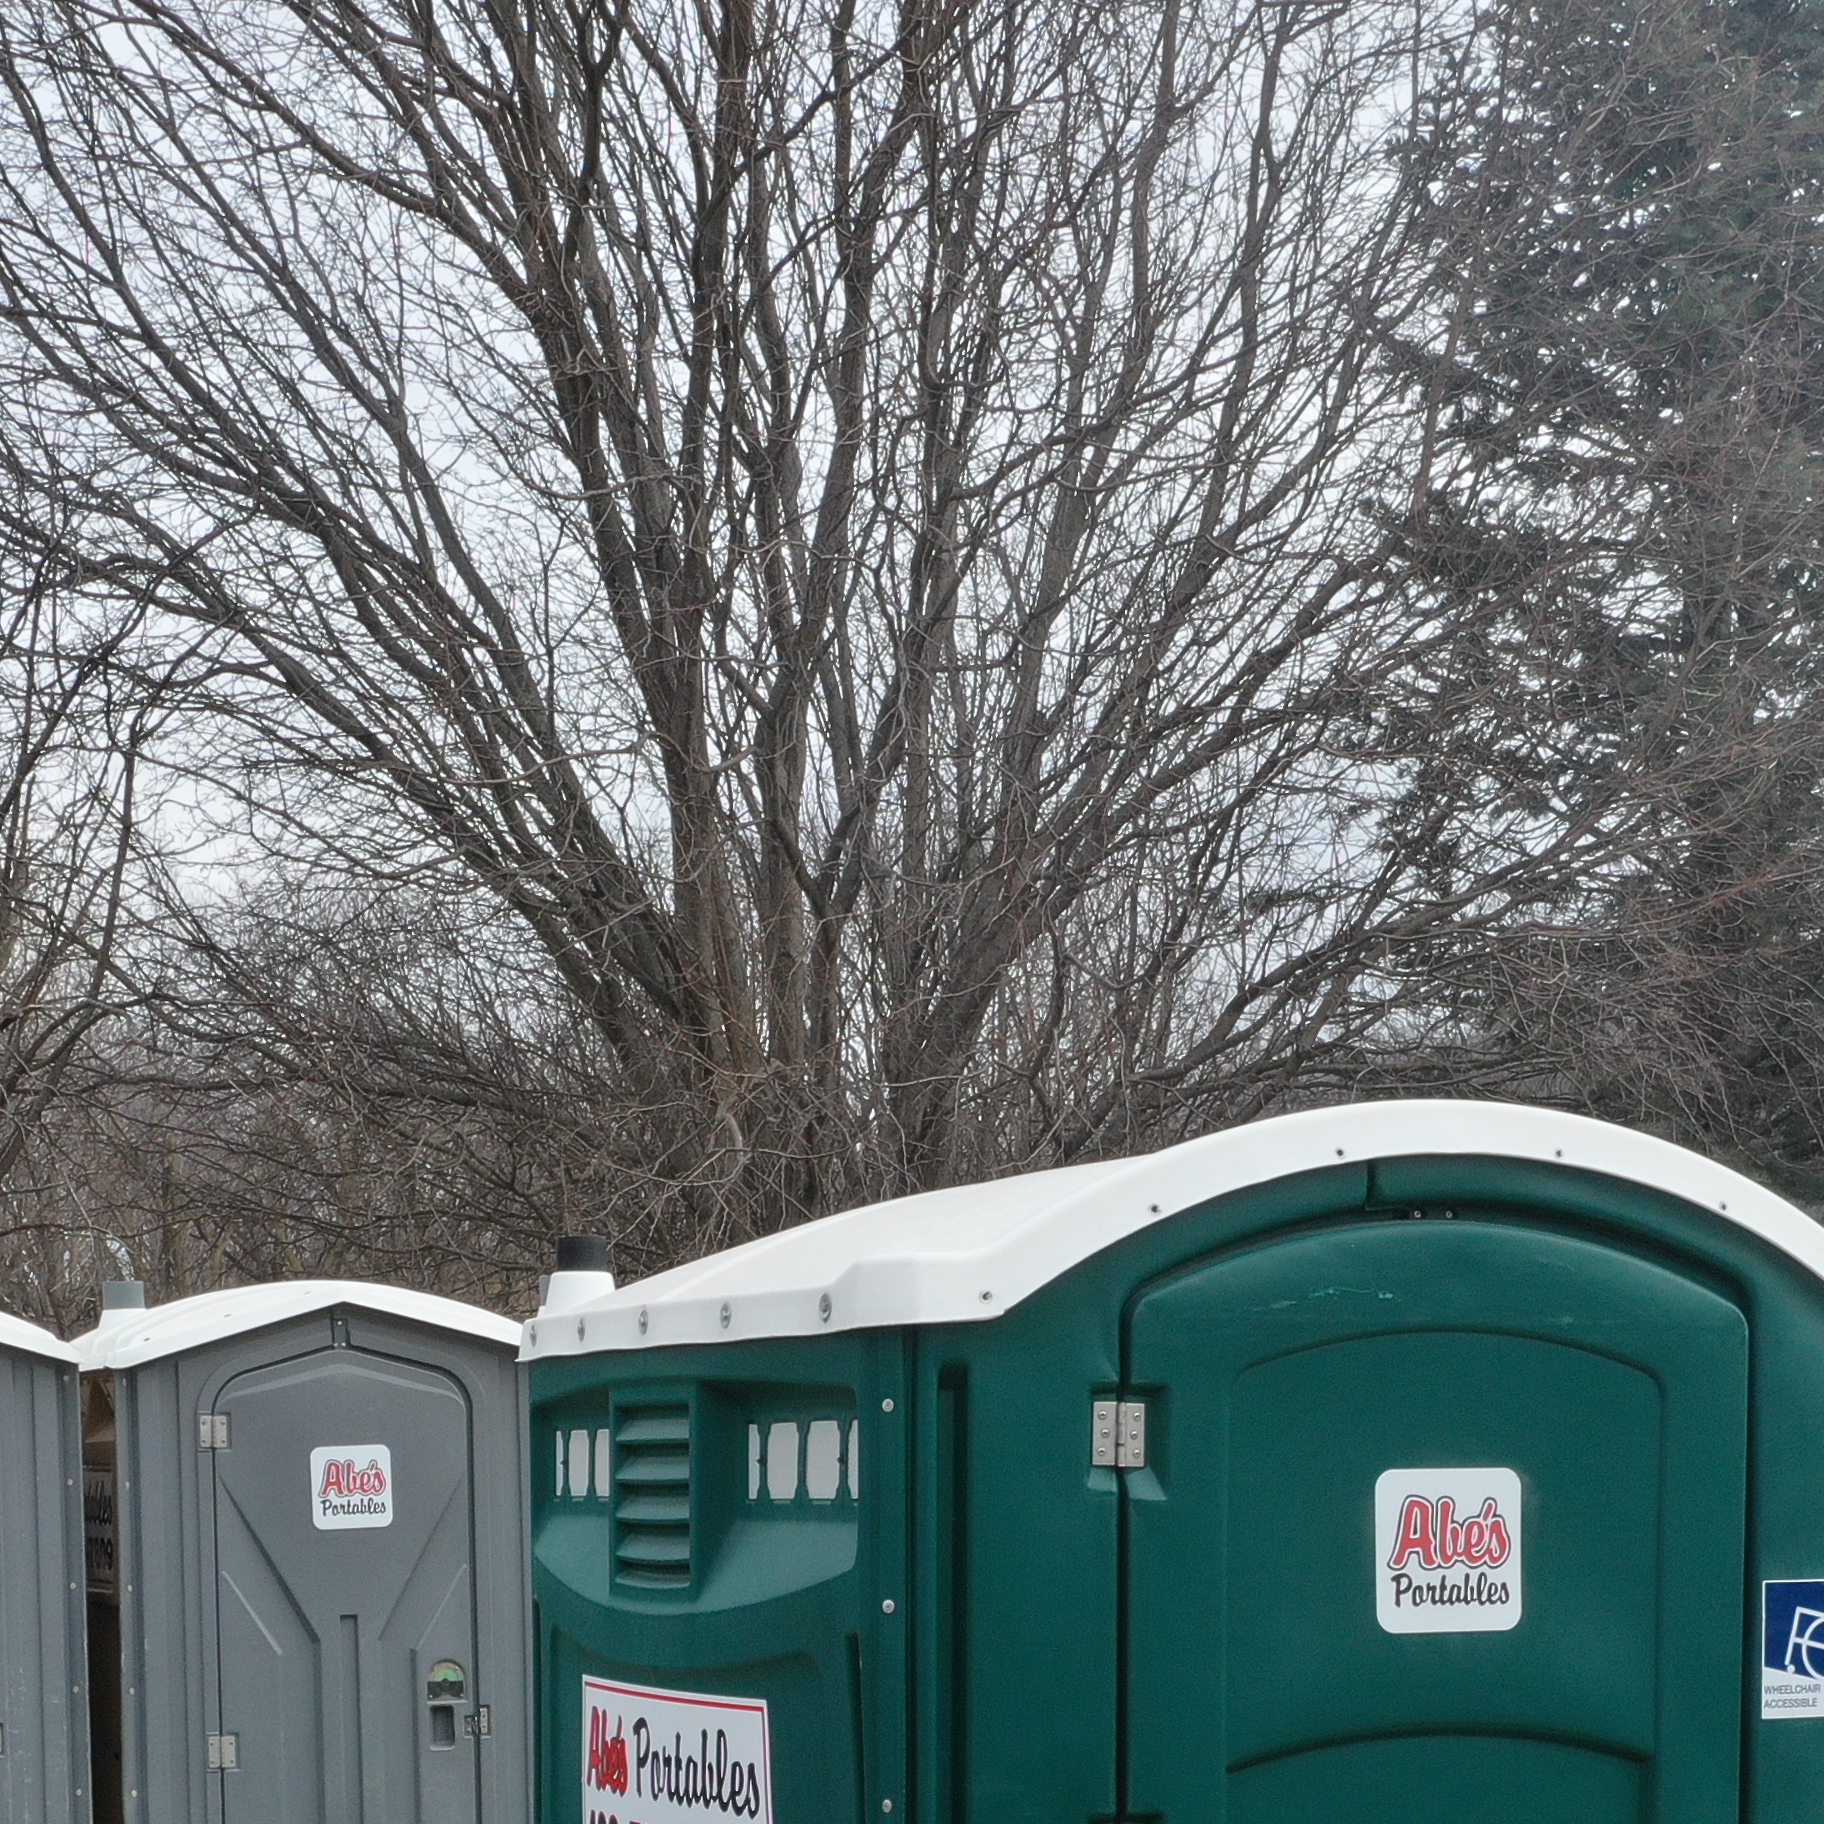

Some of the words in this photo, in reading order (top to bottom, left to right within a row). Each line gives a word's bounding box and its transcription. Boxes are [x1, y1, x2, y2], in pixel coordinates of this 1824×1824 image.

[318, 1459, 386, 1498] Abe's
[320, 1497, 386, 1517] Portables
[1387, 1494, 1511, 1571] Abe's
[1390, 1571, 1510, 1609] Portables
[1764, 1684, 1821, 1695] WHEELCHAIR
[1764, 1697, 1818, 1709] ACCESSIBLE
[587, 1705, 629, 1797] Abe's
[632, 1717, 760, 1819] Portables
